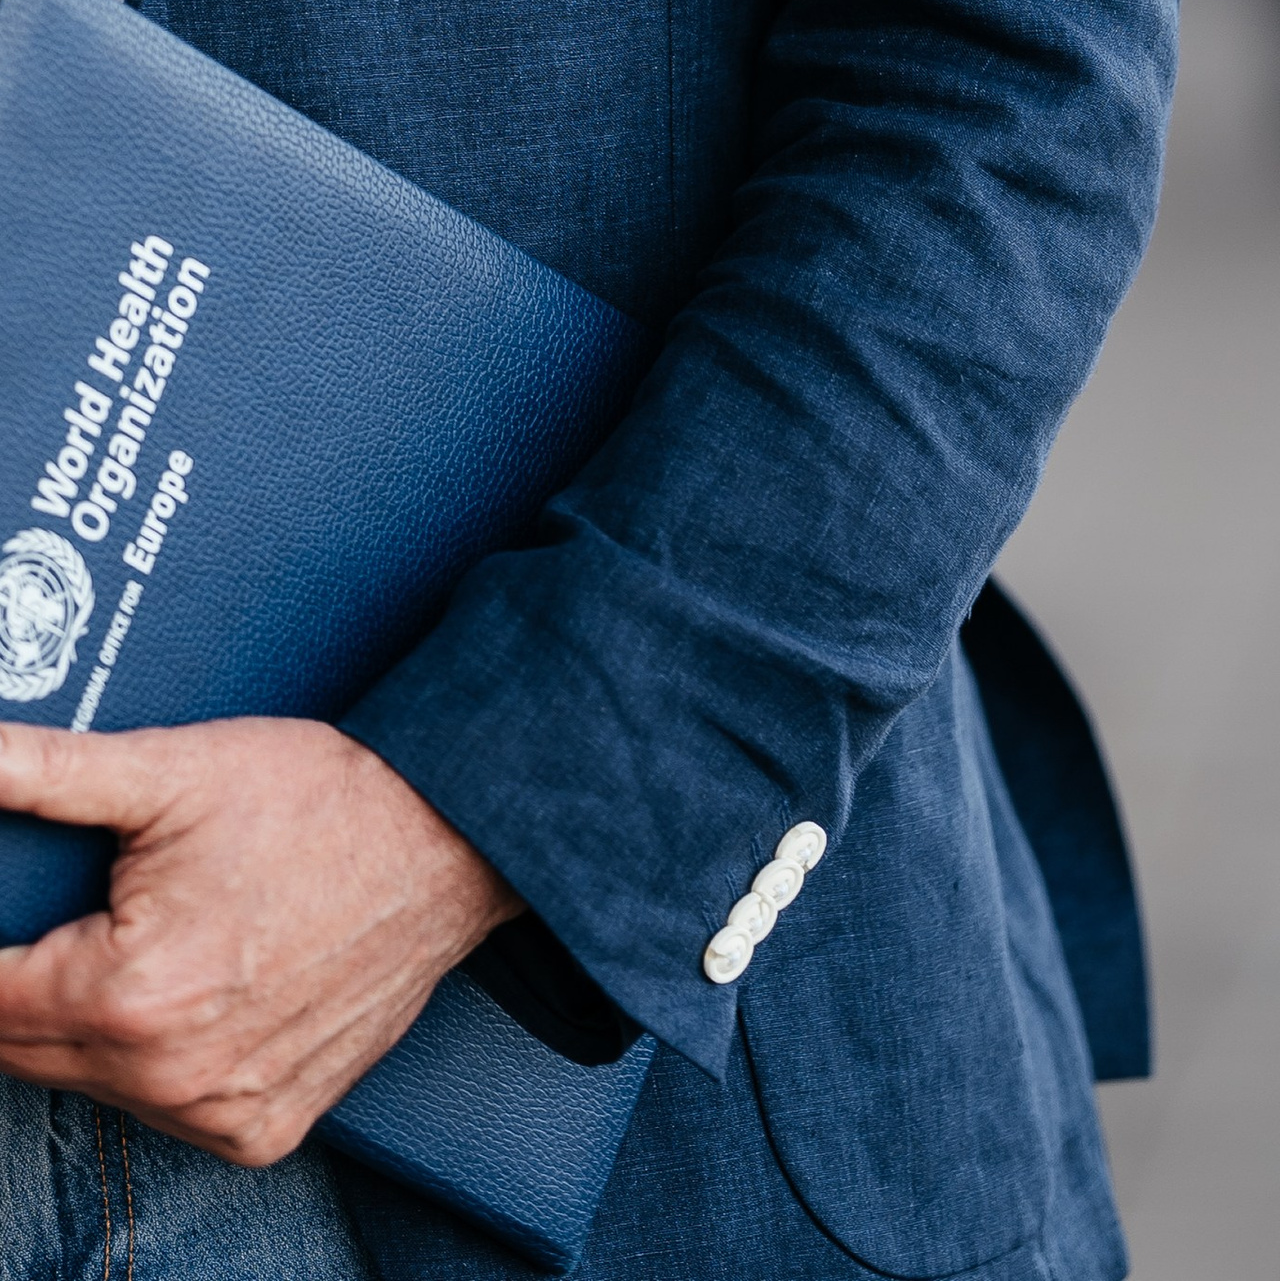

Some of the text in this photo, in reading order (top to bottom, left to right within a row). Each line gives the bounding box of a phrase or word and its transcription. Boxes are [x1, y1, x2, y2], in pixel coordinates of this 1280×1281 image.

[31, 234, 174, 518] World Health
[71, 255, 211, 541] Organization
[71, 449, 194, 733] EGIONAL OFFICE FOR Europe
